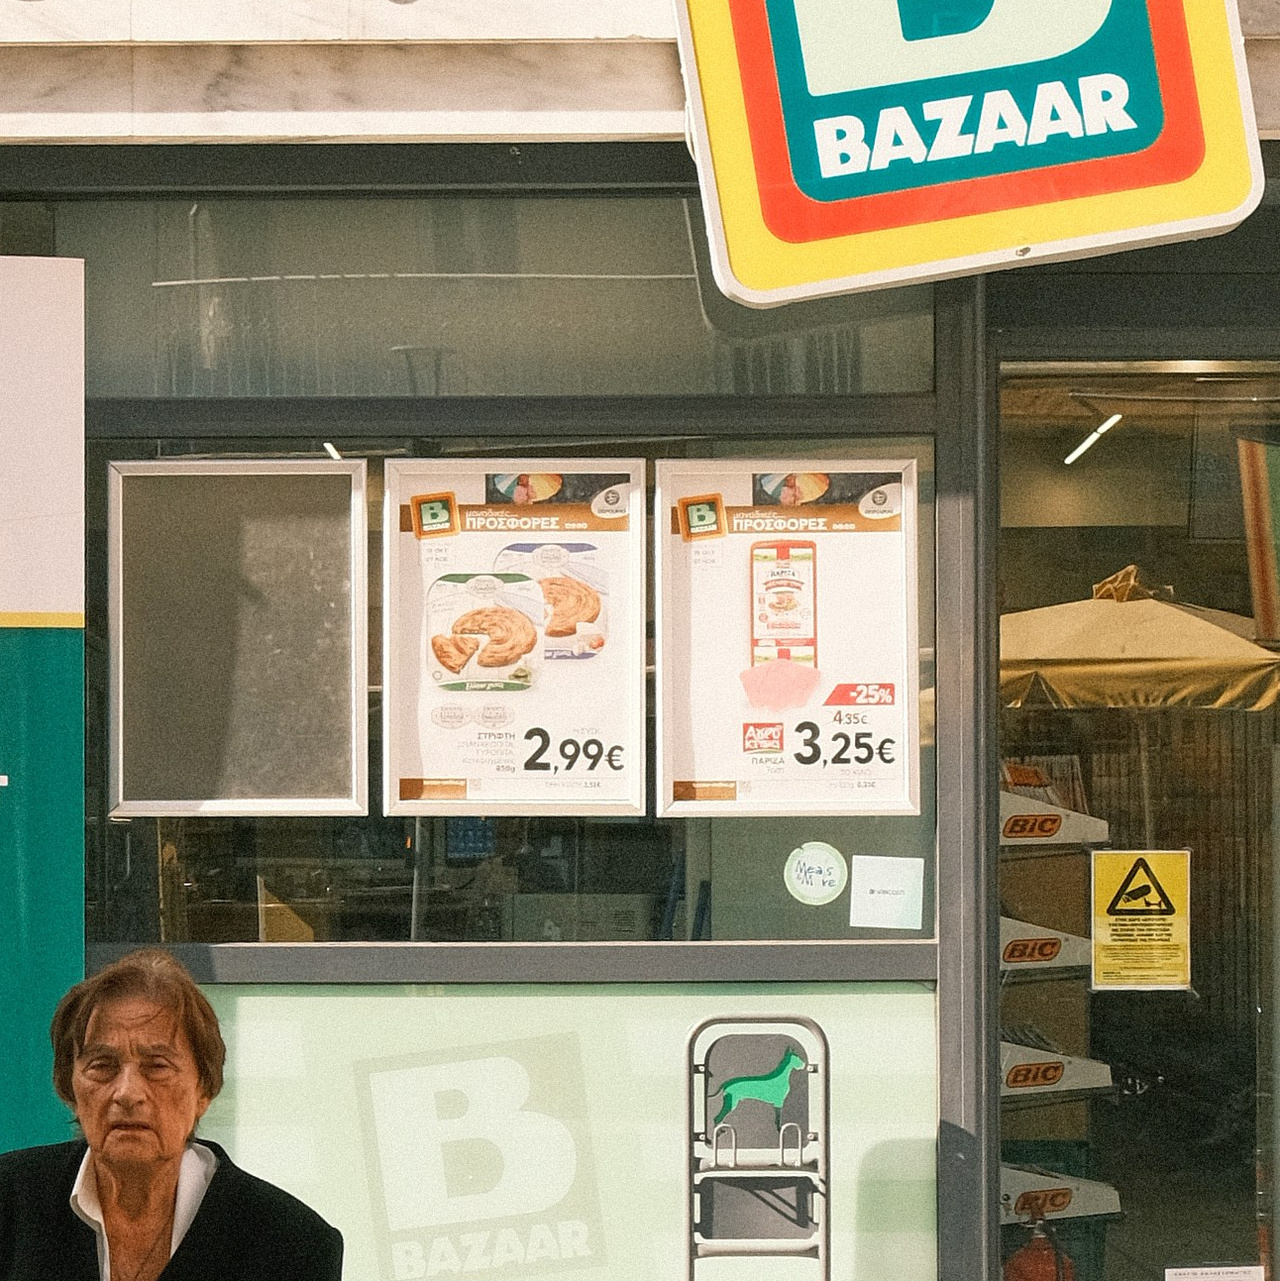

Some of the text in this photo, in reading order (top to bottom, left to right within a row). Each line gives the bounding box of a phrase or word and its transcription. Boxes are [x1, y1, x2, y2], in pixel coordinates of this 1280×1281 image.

[813, 73, 1138, 179] BAZAAR
[465, 516, 560, 530] ΠΡΟΣΦΟΡΕΣ
[733, 518, 828, 531] ΠΡΟΣΦΟΡΕΣ
[850, 685, 893, 704] -25%
[523, 727, 625, 775] 2,99€
[793, 720, 897, 769] 3,25€
[1007, 818, 1059, 835] BIC
[1007, 942, 1058, 960] BIC
[369, 1056, 578, 1231] B
[390, 1220, 593, 1281] BAZAAR
